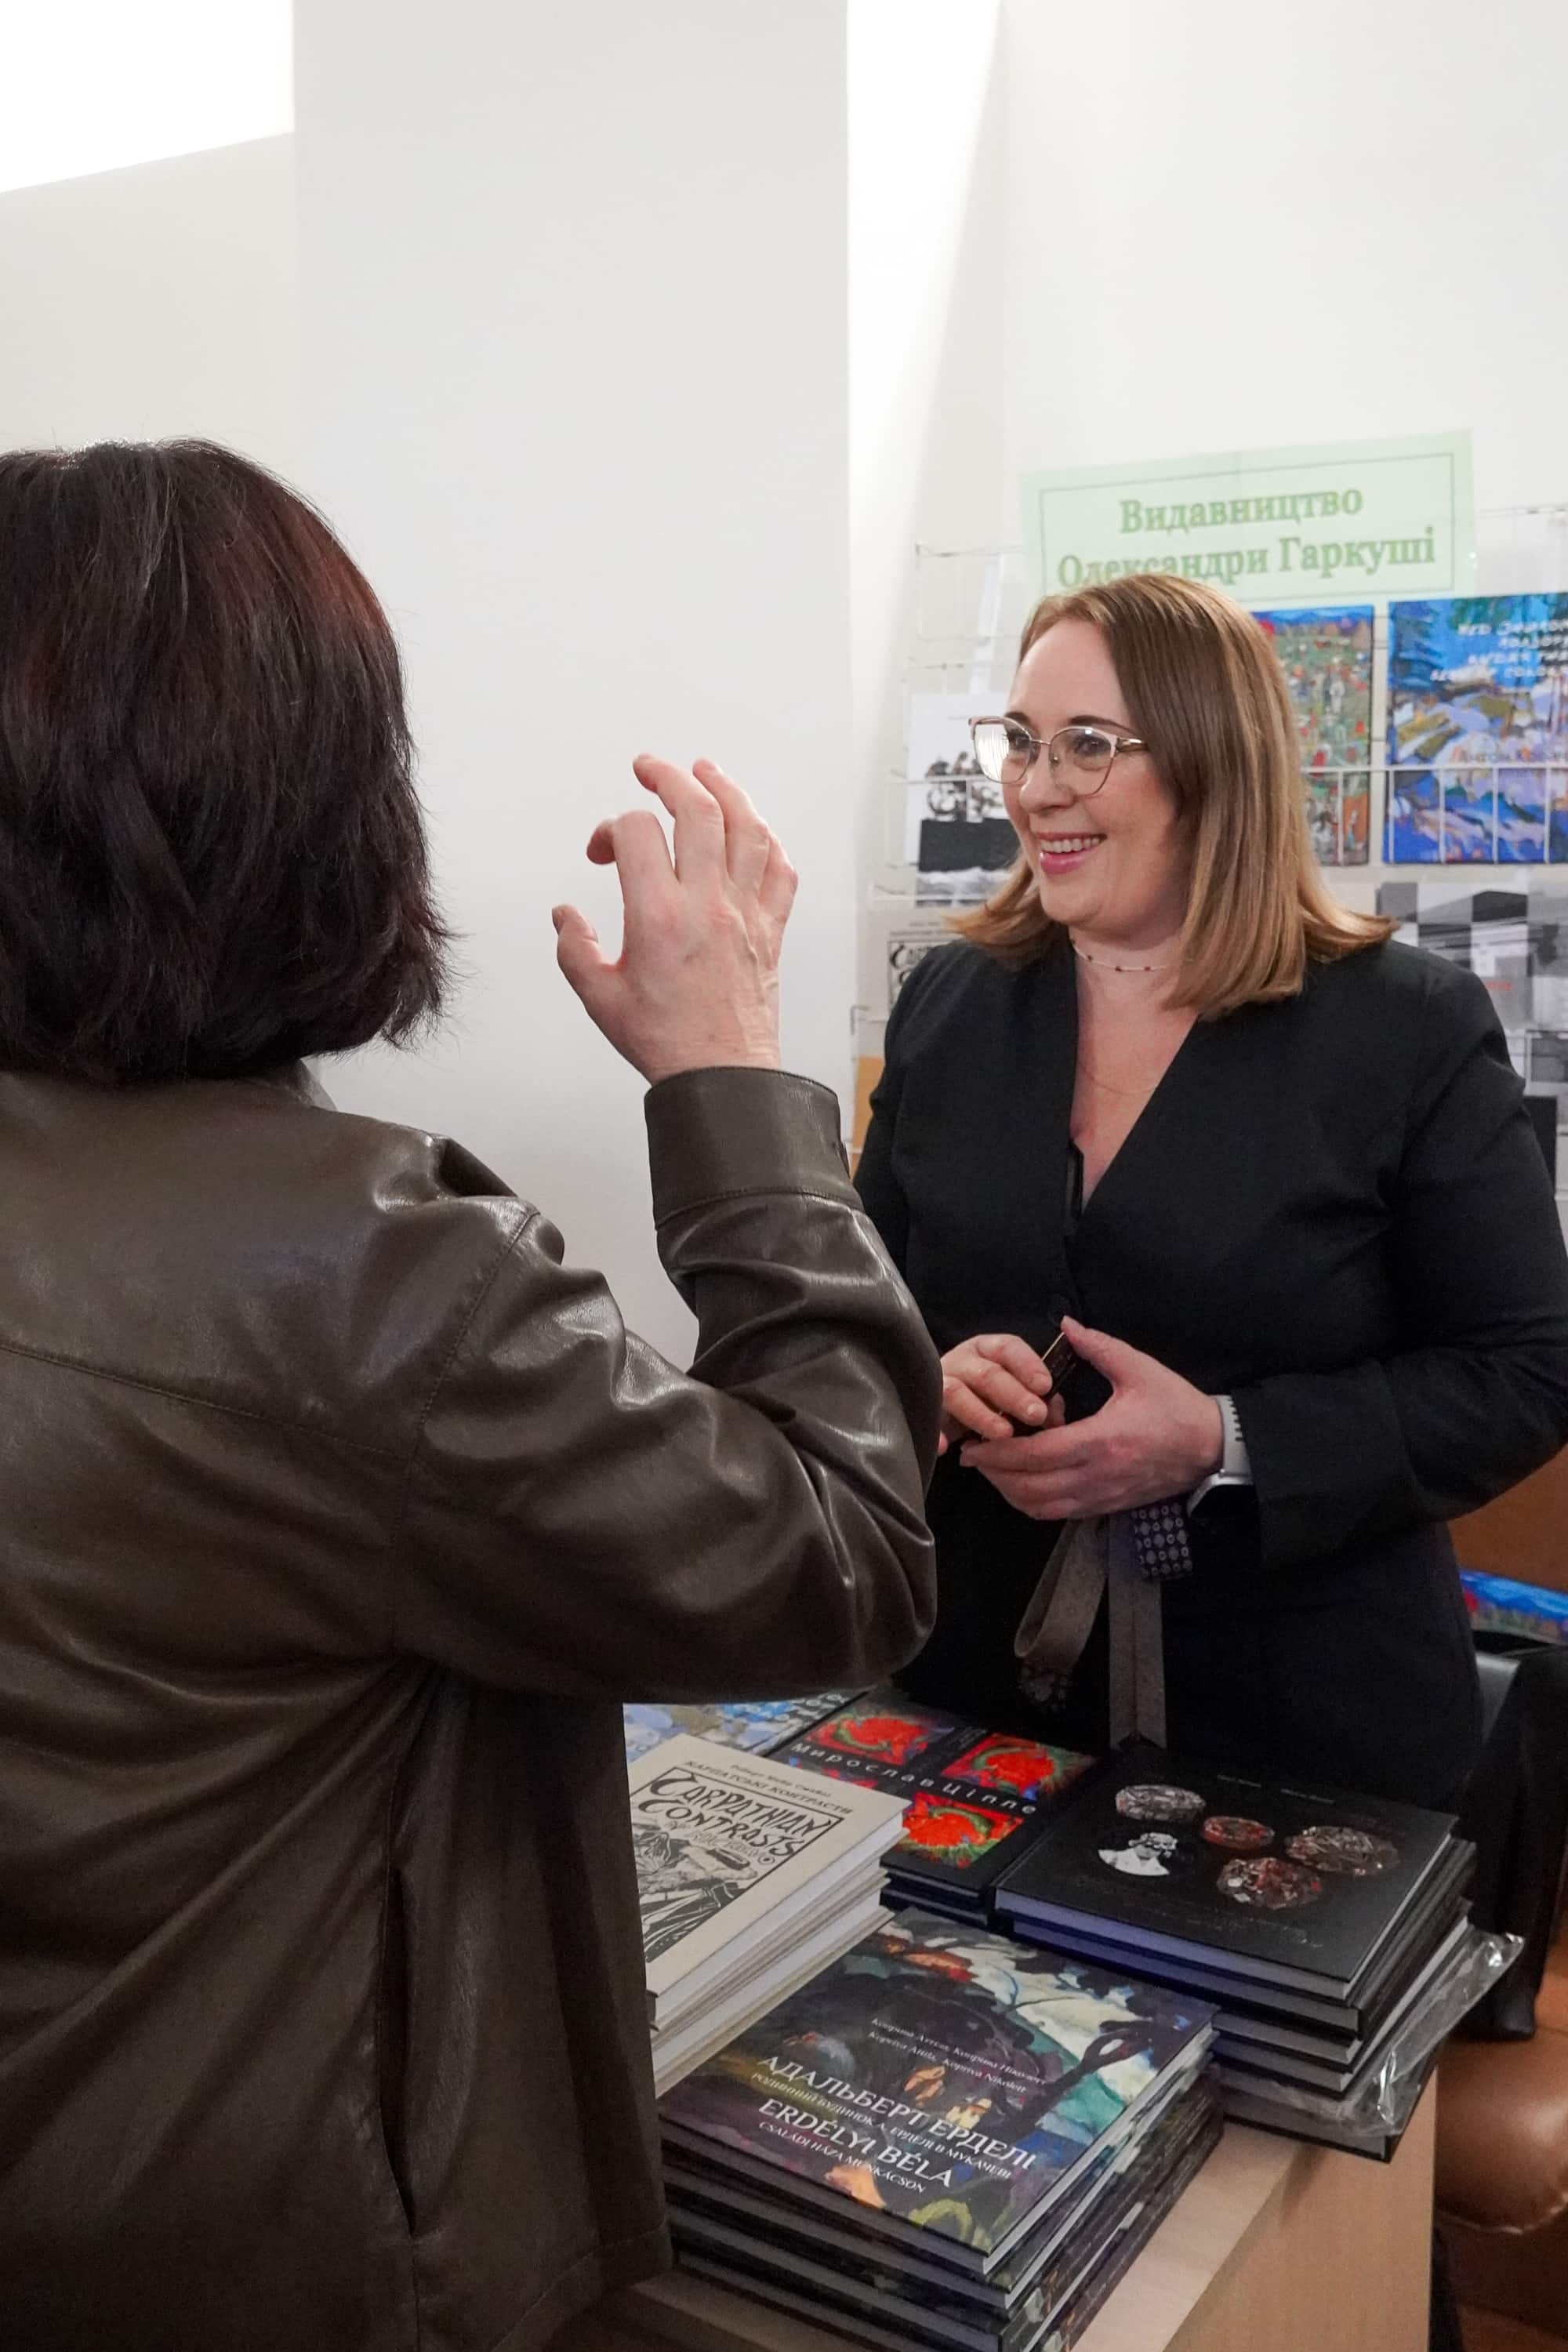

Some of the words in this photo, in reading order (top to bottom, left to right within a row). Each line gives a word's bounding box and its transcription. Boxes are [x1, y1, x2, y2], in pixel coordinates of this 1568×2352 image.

[1119, 488, 1363, 535] Видавництво
[1058, 548, 1269, 589] Олександри
[1279, 524, 1436, 579] Гаркуші
[790, 1742, 935, 1788] Мирослав
[637, 1798, 805, 1857] CONTRASTS
[649, 1772, 831, 1837] CARPATHIAN
[757, 2056, 931, 2125] АДАЛЬБЕРТ
[928, 2119, 1036, 2170] ЕРДЕЛІ
[758, 2098, 877, 2155] ERDÉLYI
[877, 2145, 953, 2188] BÉLA
[890, 2126, 935, 2149] ЕРДЕЛІ
[935, 2143, 946, 2154] В
[945, 2147, 1013, 2180] МУКАЧЕВІ
